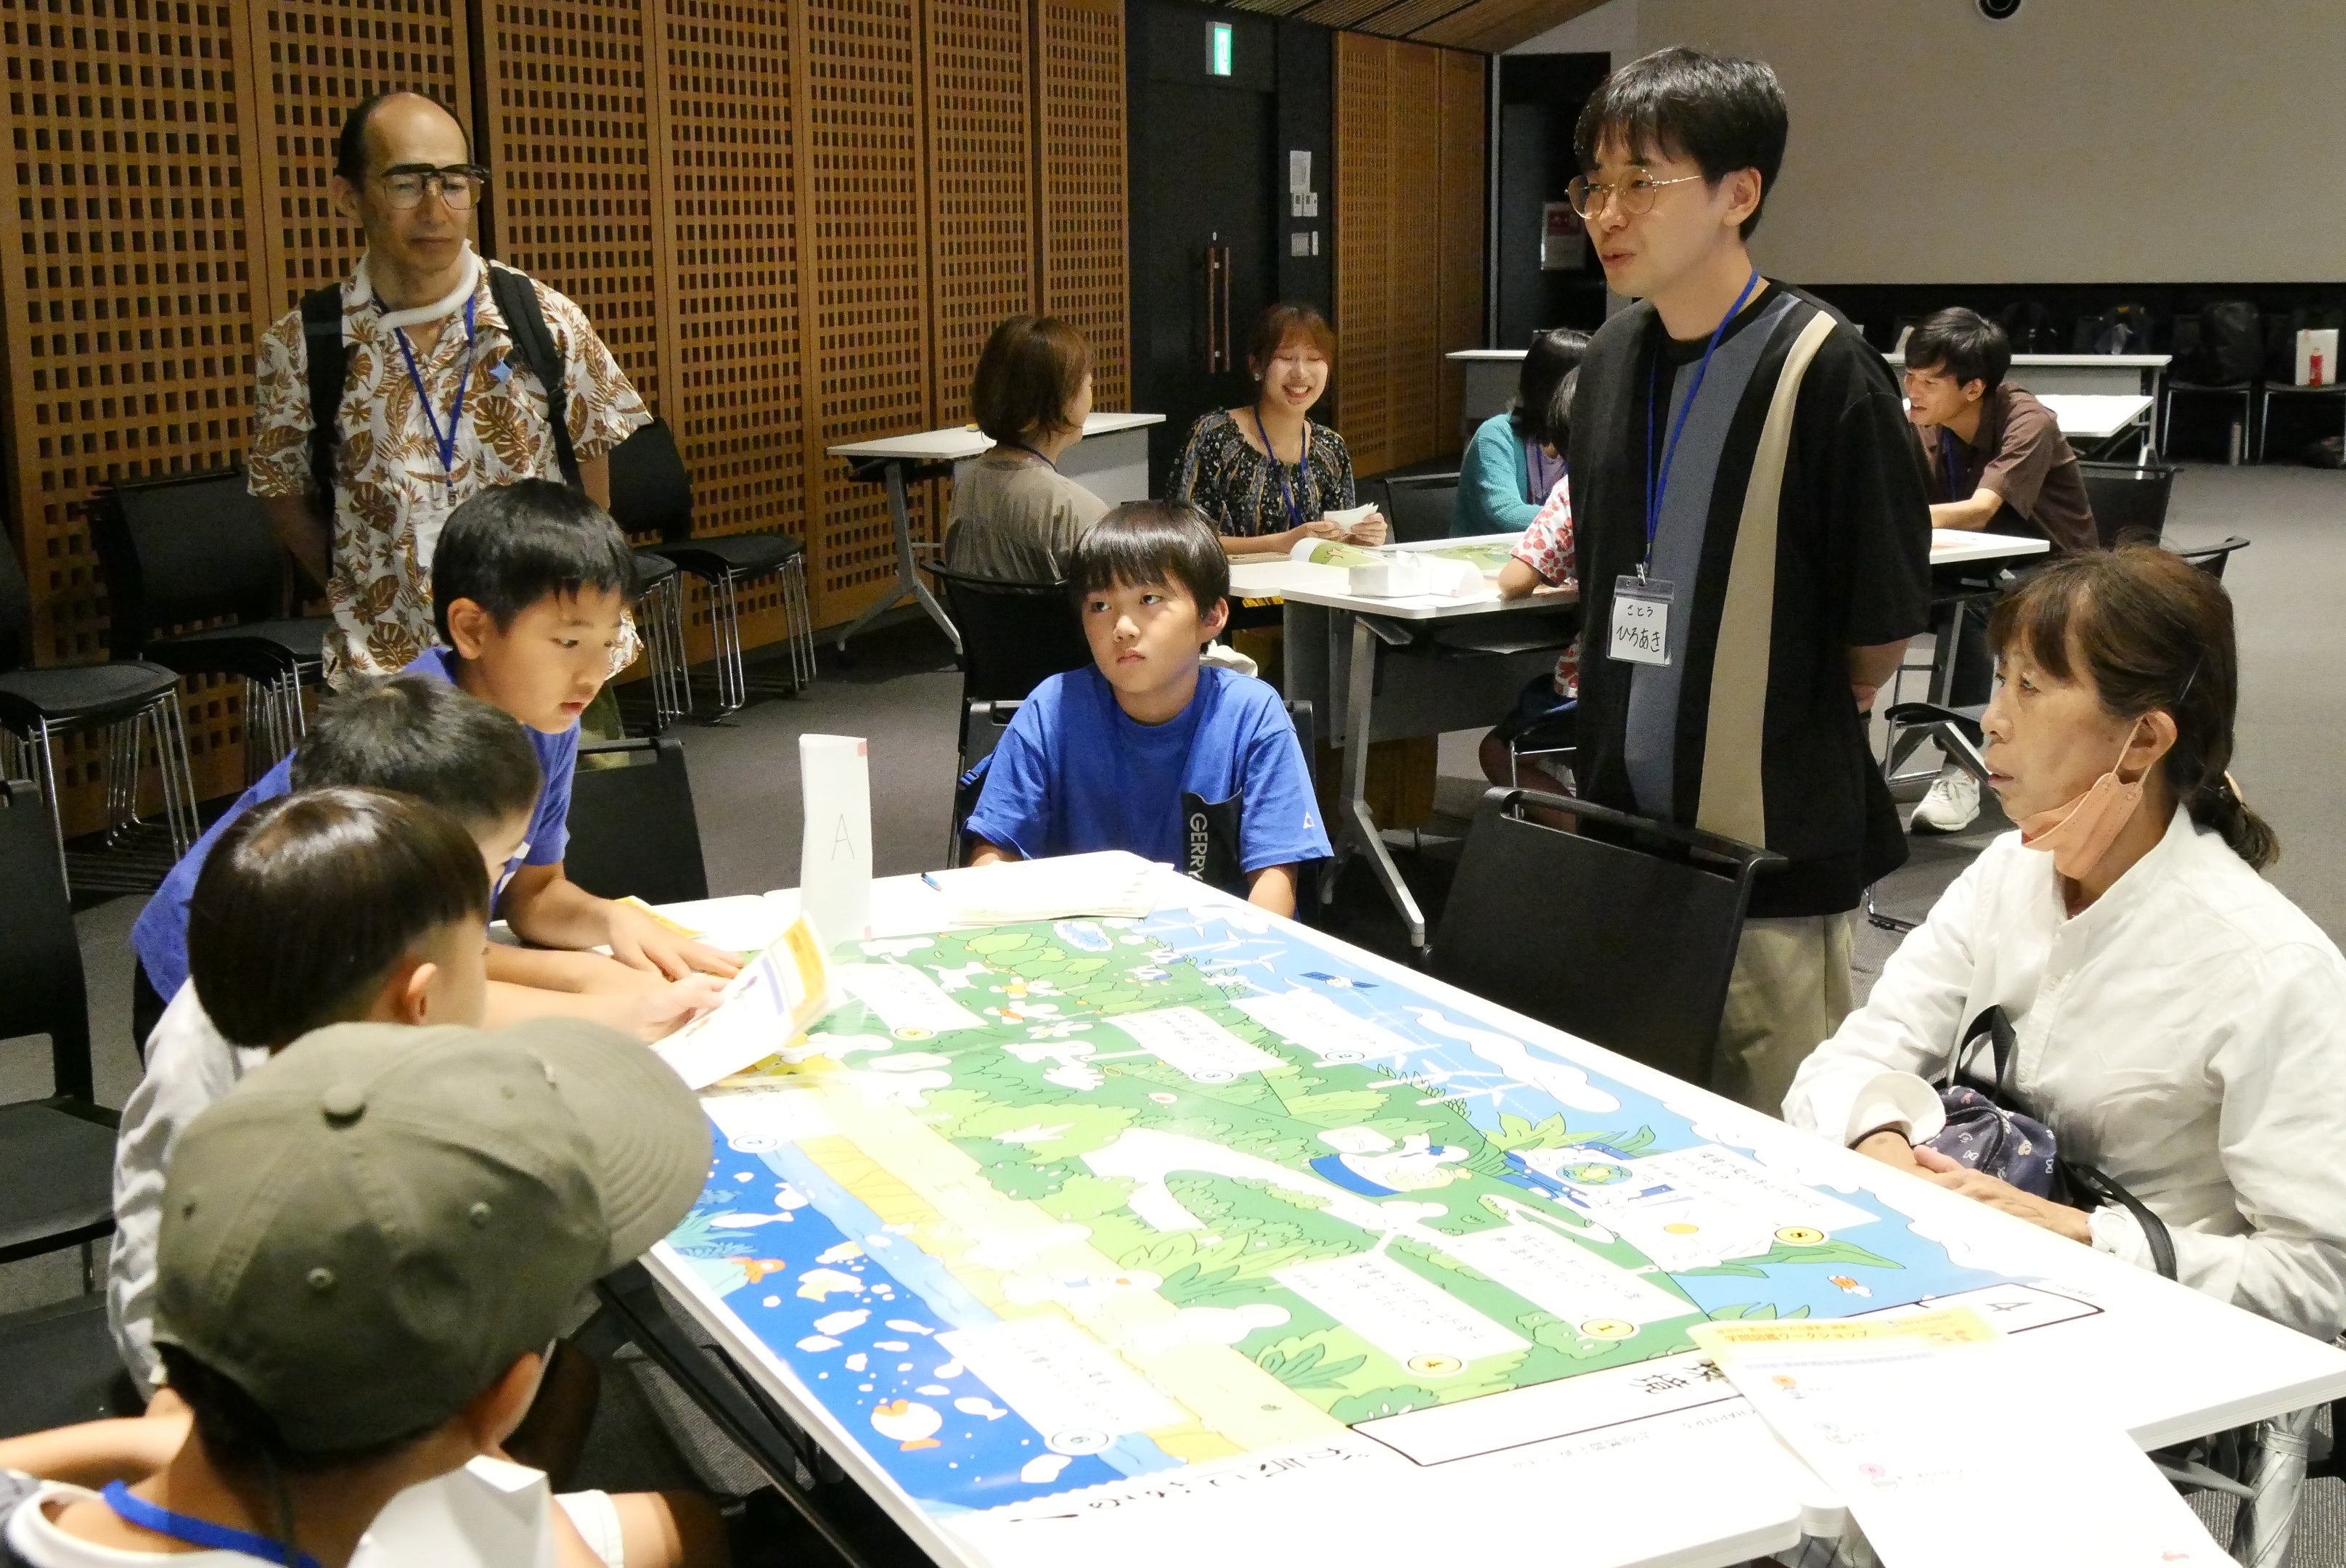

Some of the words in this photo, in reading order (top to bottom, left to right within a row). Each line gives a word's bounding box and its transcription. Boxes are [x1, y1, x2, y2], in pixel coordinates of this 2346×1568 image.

[1616, 625, 1661, 653] ひろあき
[830, 813, 857, 861] A
[1724, 1329, 1868, 1343] 学問図鑑ワークショップ
